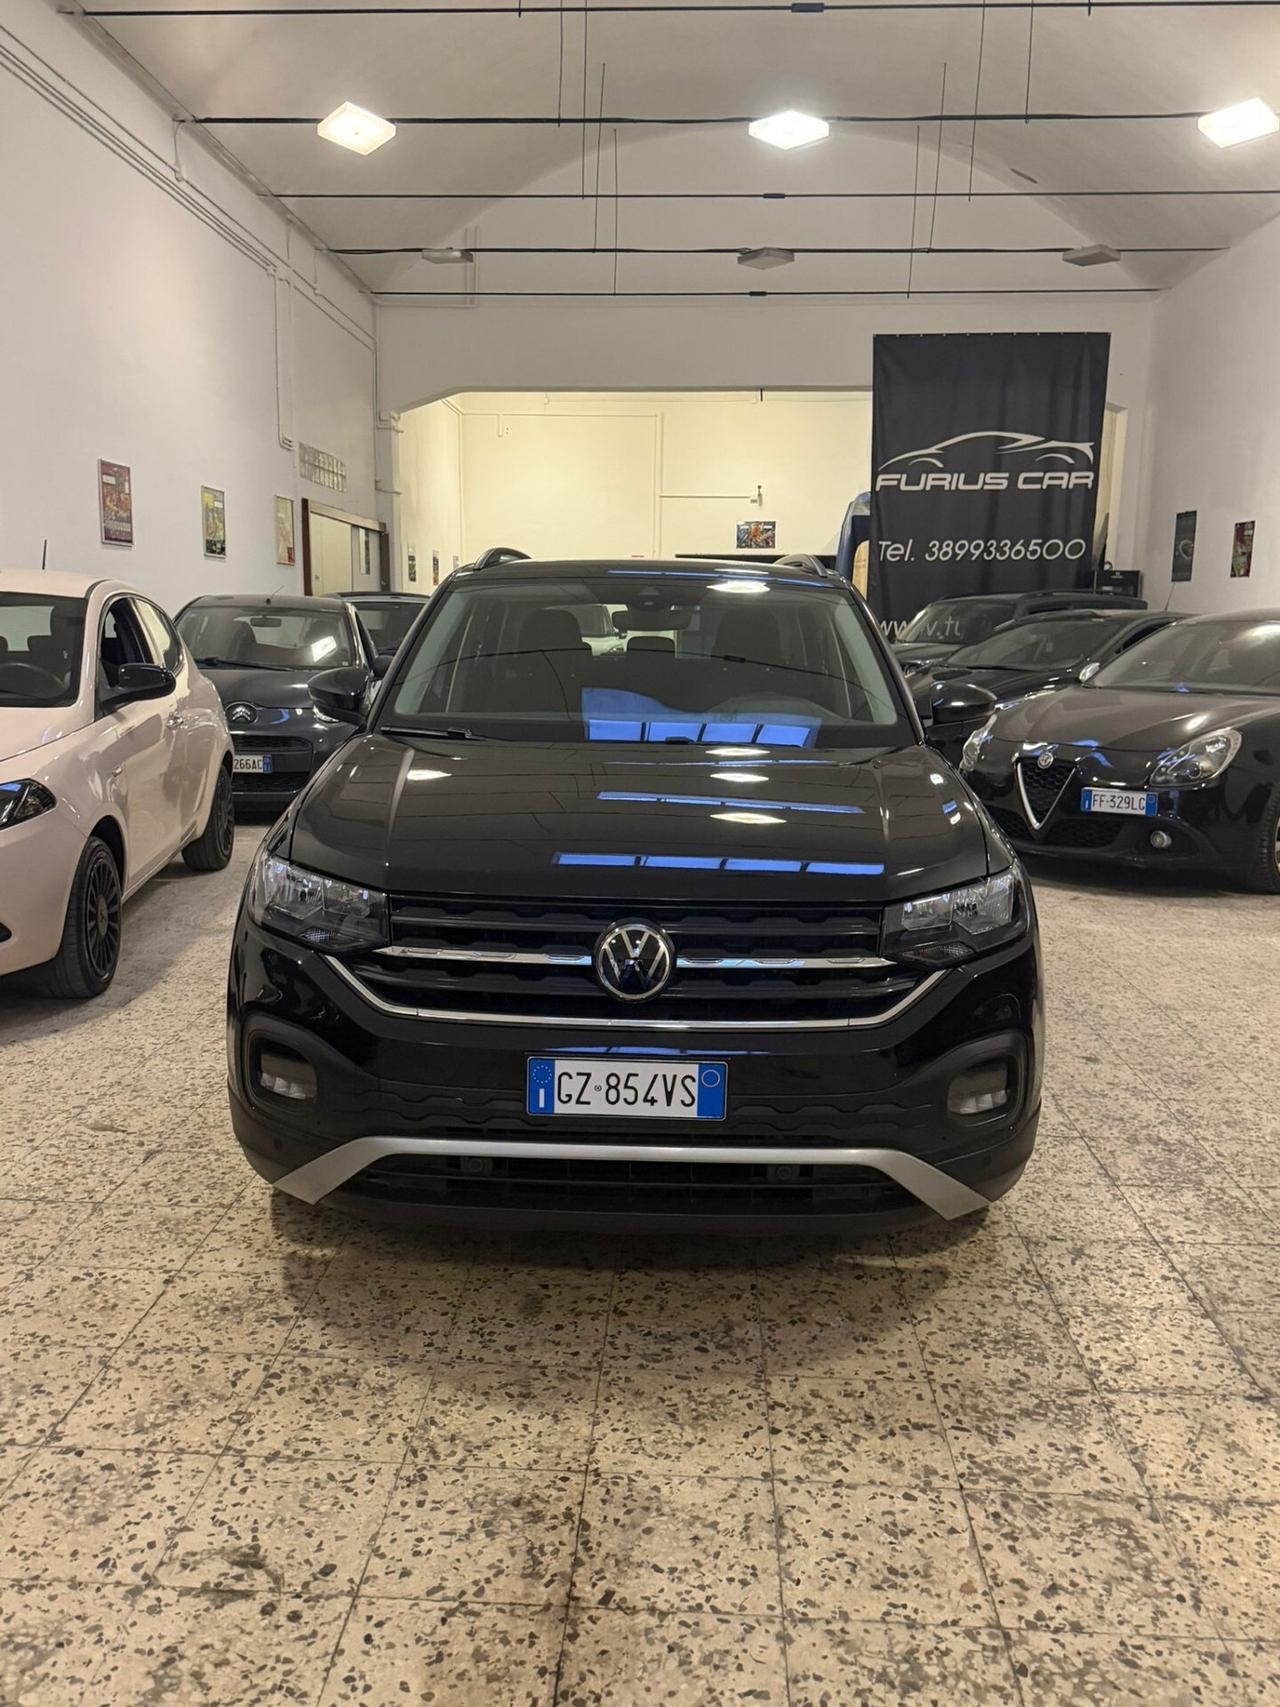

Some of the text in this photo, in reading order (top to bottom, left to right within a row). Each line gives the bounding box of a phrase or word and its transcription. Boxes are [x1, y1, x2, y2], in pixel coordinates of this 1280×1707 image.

[875, 471, 1094, 491] FURIUS CAR
[878, 538, 1086, 562] Tel. 3899336500
[557, 1071, 592, 1105] GZ
[605, 1072, 697, 1107] 854VS
